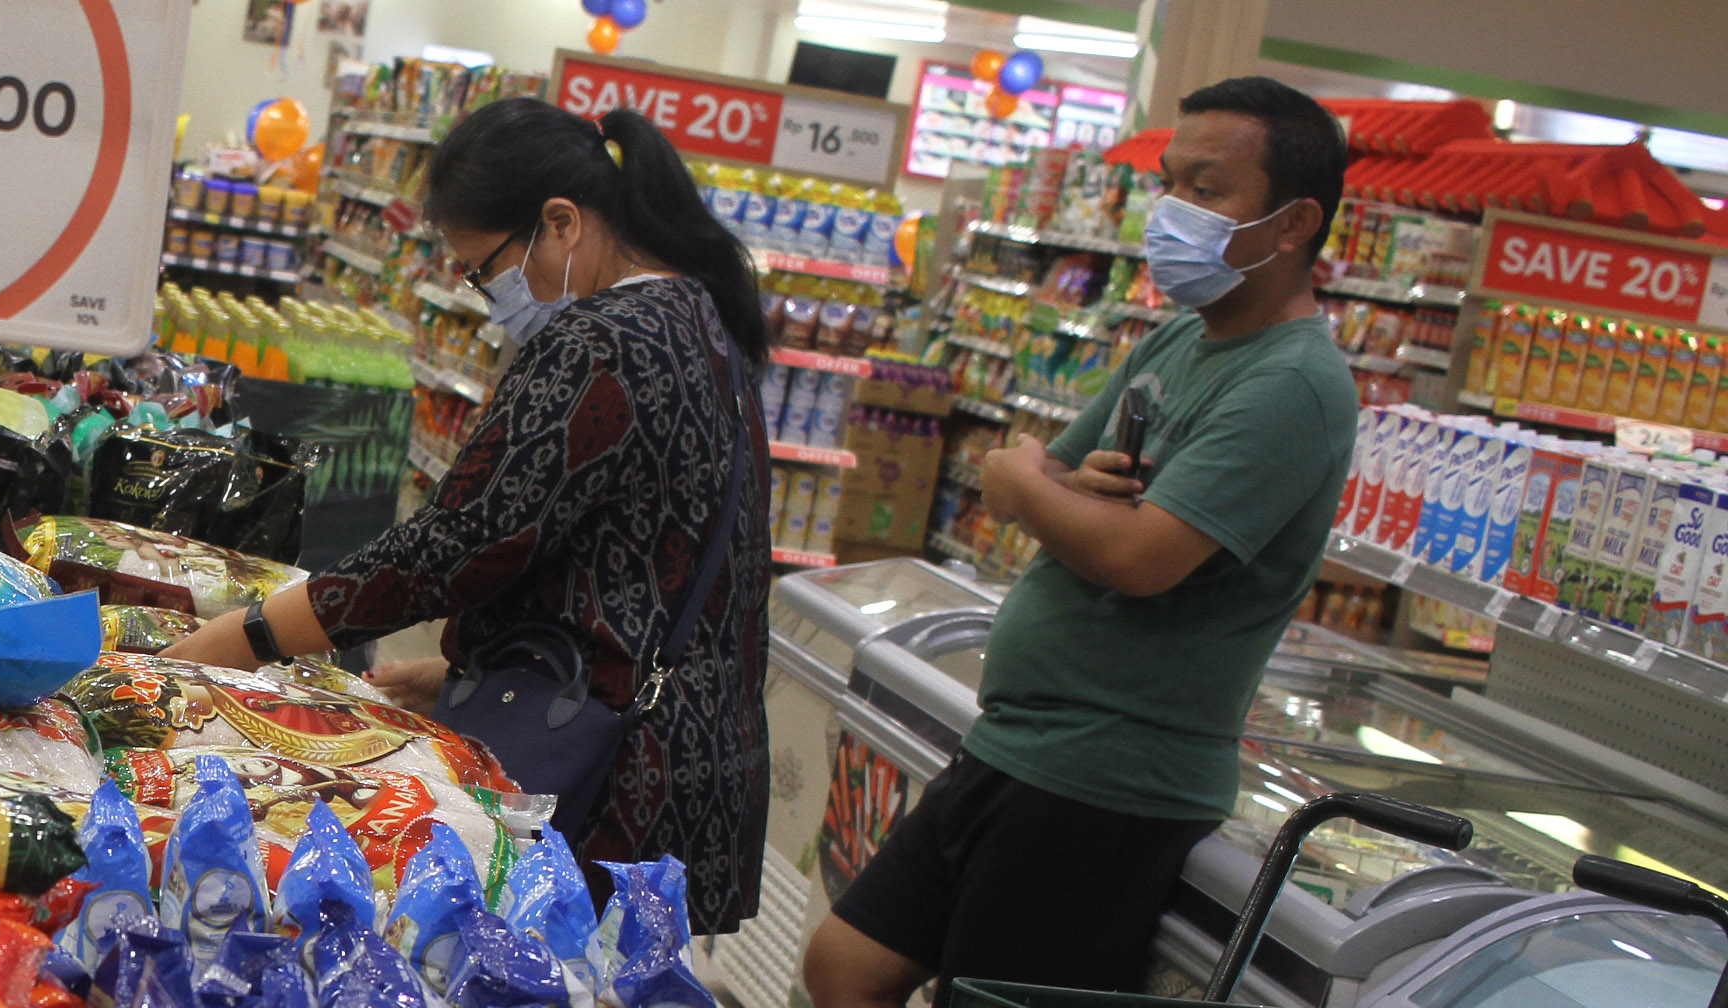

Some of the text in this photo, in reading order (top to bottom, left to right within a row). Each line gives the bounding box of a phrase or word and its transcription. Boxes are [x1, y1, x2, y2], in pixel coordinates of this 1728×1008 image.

[564, 76, 682, 130] SAVE
[808, 121, 842, 154] 16
[1499, 237, 1613, 289] SAVE
[69, 295, 107, 311] SAVE
